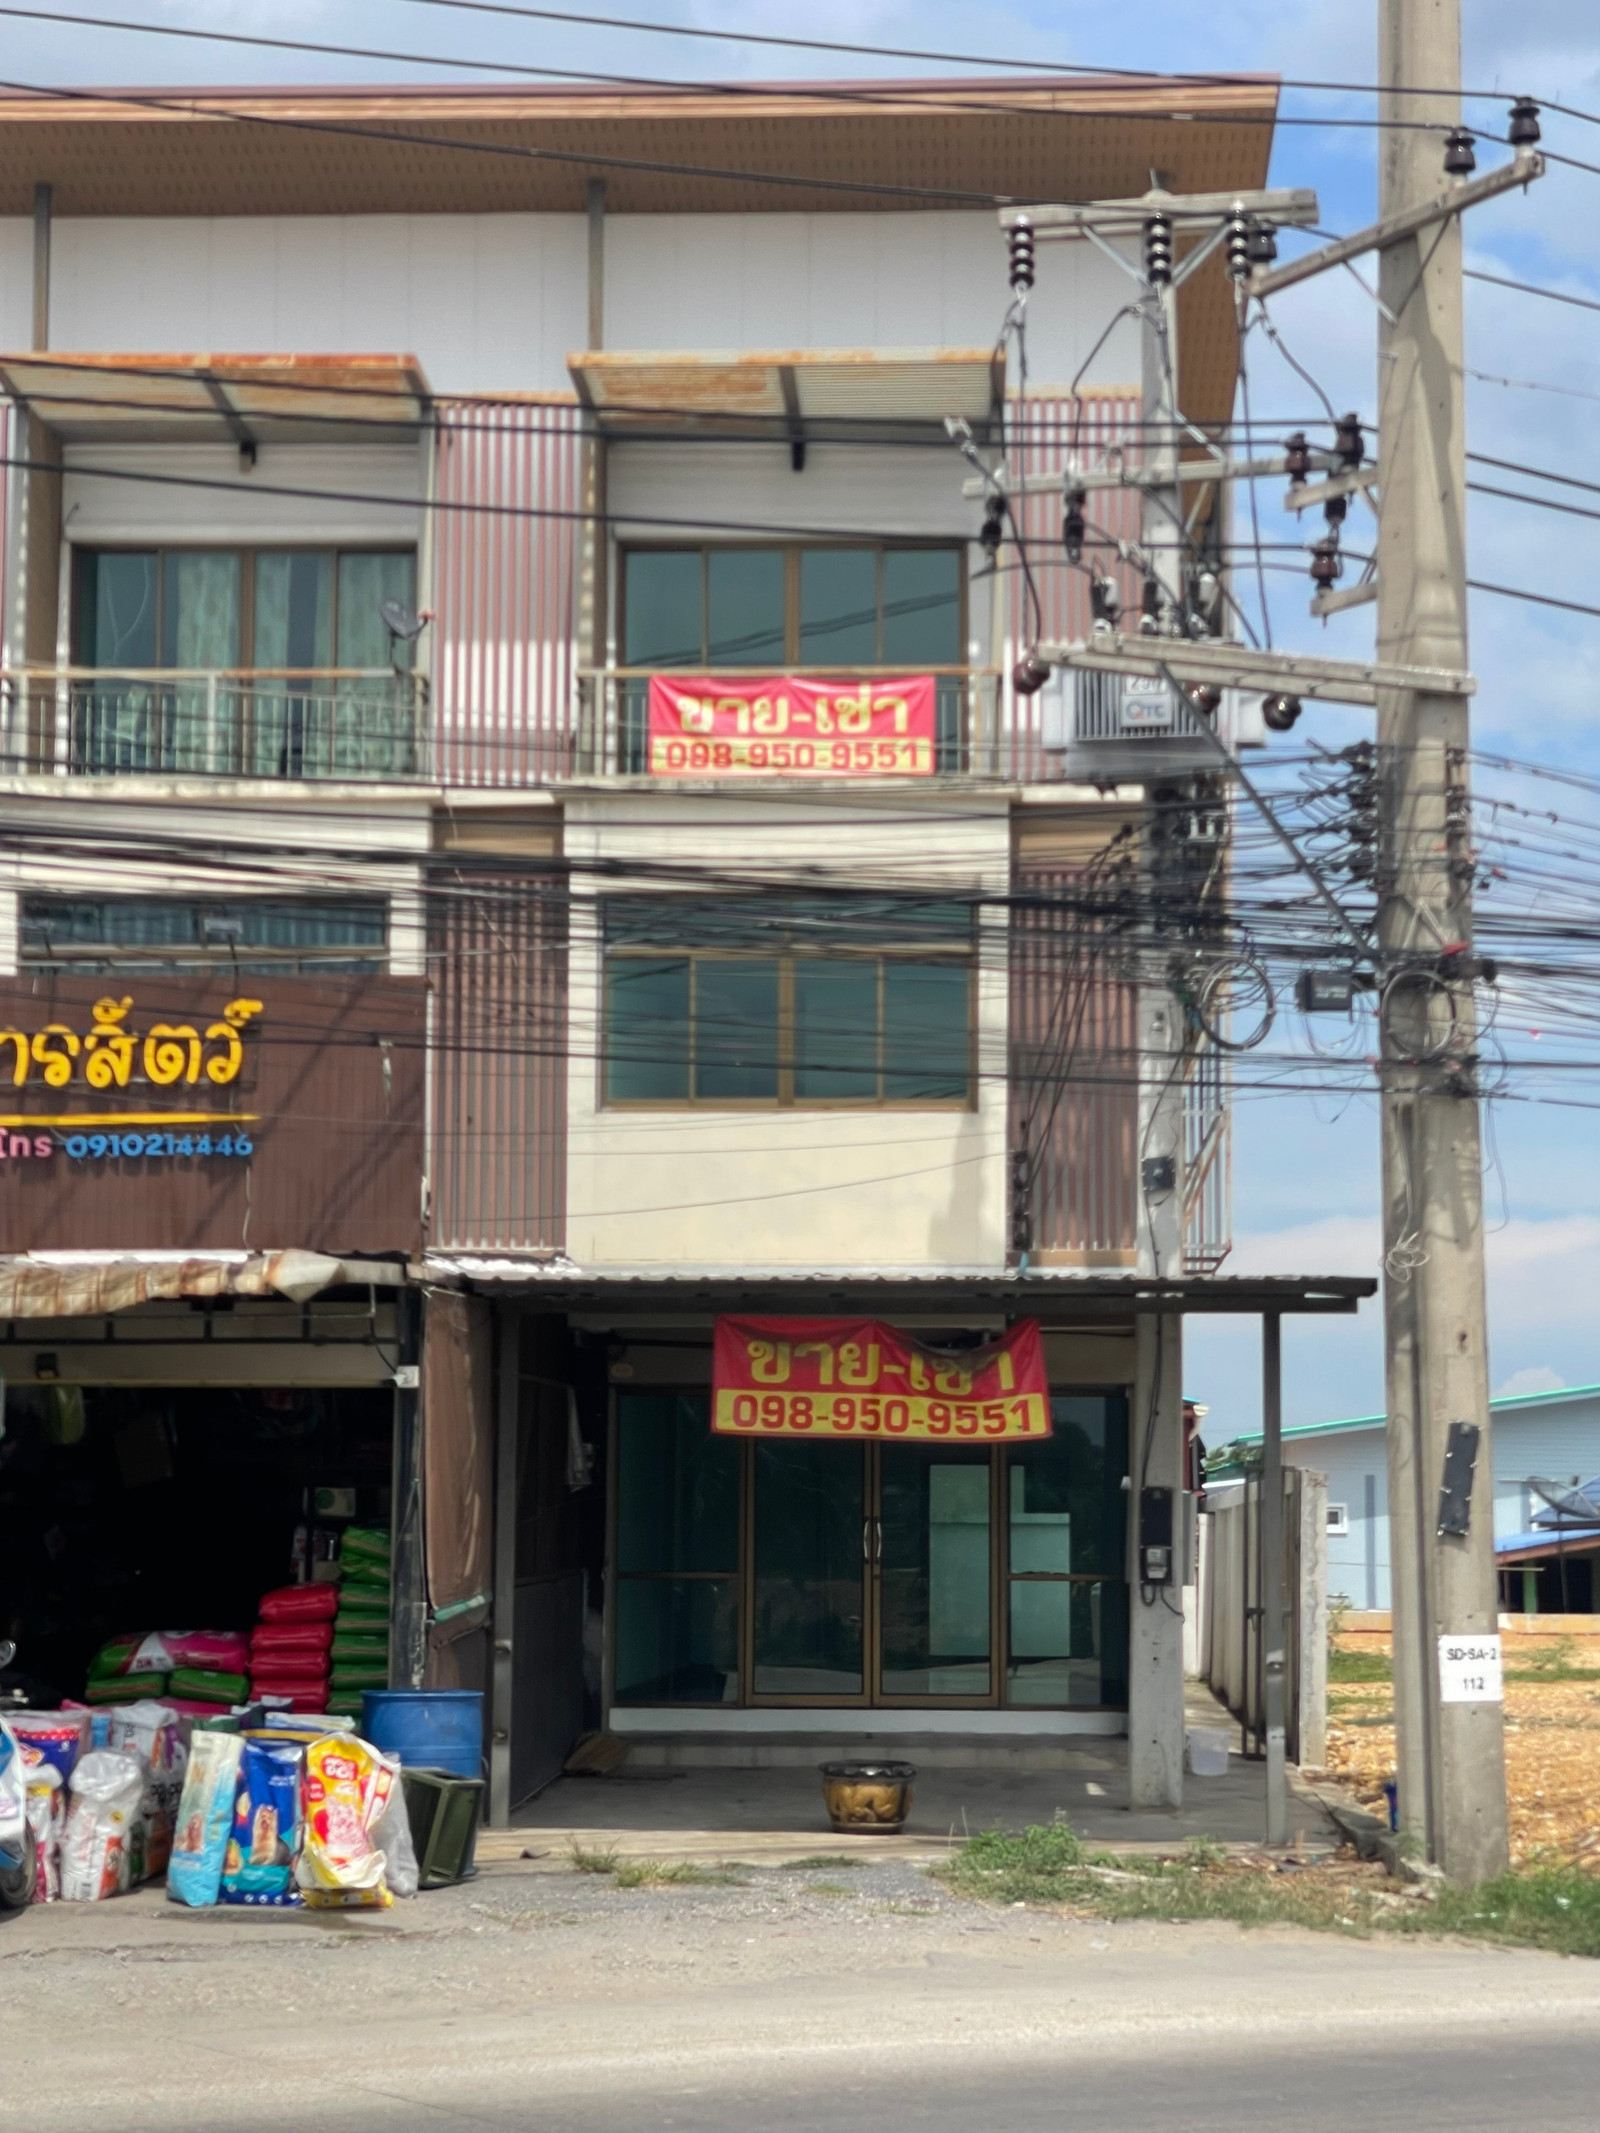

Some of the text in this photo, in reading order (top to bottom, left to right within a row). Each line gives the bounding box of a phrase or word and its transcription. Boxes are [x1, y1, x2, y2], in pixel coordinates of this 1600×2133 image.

[676, 681, 908, 734] ขาย-เช่า
[665, 741, 918, 770] 098-950-9551
[66, 1134, 254, 1158] 0910214446
[732, 1394, 1031, 1435] 098-950-9551
[1463, 1677, 1485, 1691] 112
